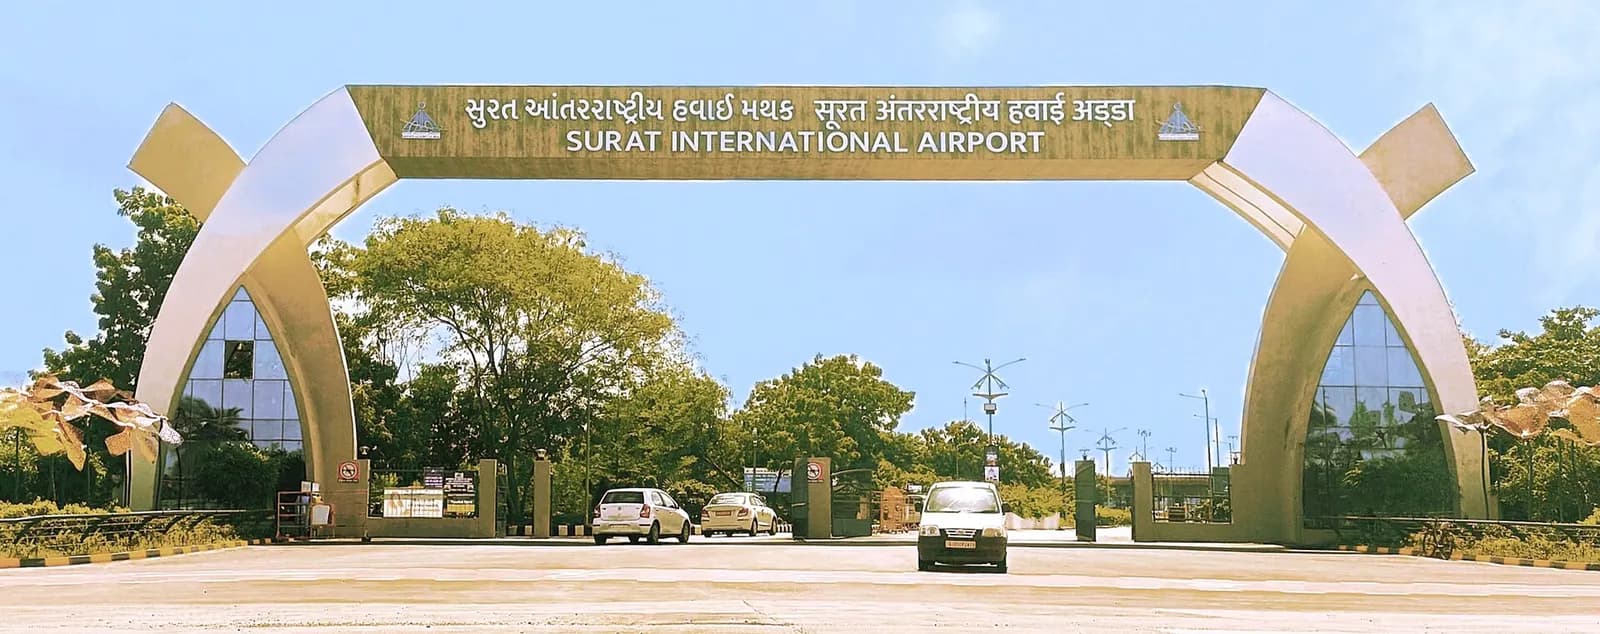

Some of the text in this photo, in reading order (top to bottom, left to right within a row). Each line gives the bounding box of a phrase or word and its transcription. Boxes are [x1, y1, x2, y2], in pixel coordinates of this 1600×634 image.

[465, 92, 794, 129] સુરત આંતરરાષ્ટ્રીય હવાઈ મથક
[814, 92, 1136, 130] सूरत अंतरराष्ट्रीय हवाई अड्डा
[566, 130, 1045, 153] SURAT INTERNATIONAL AIRPORT
